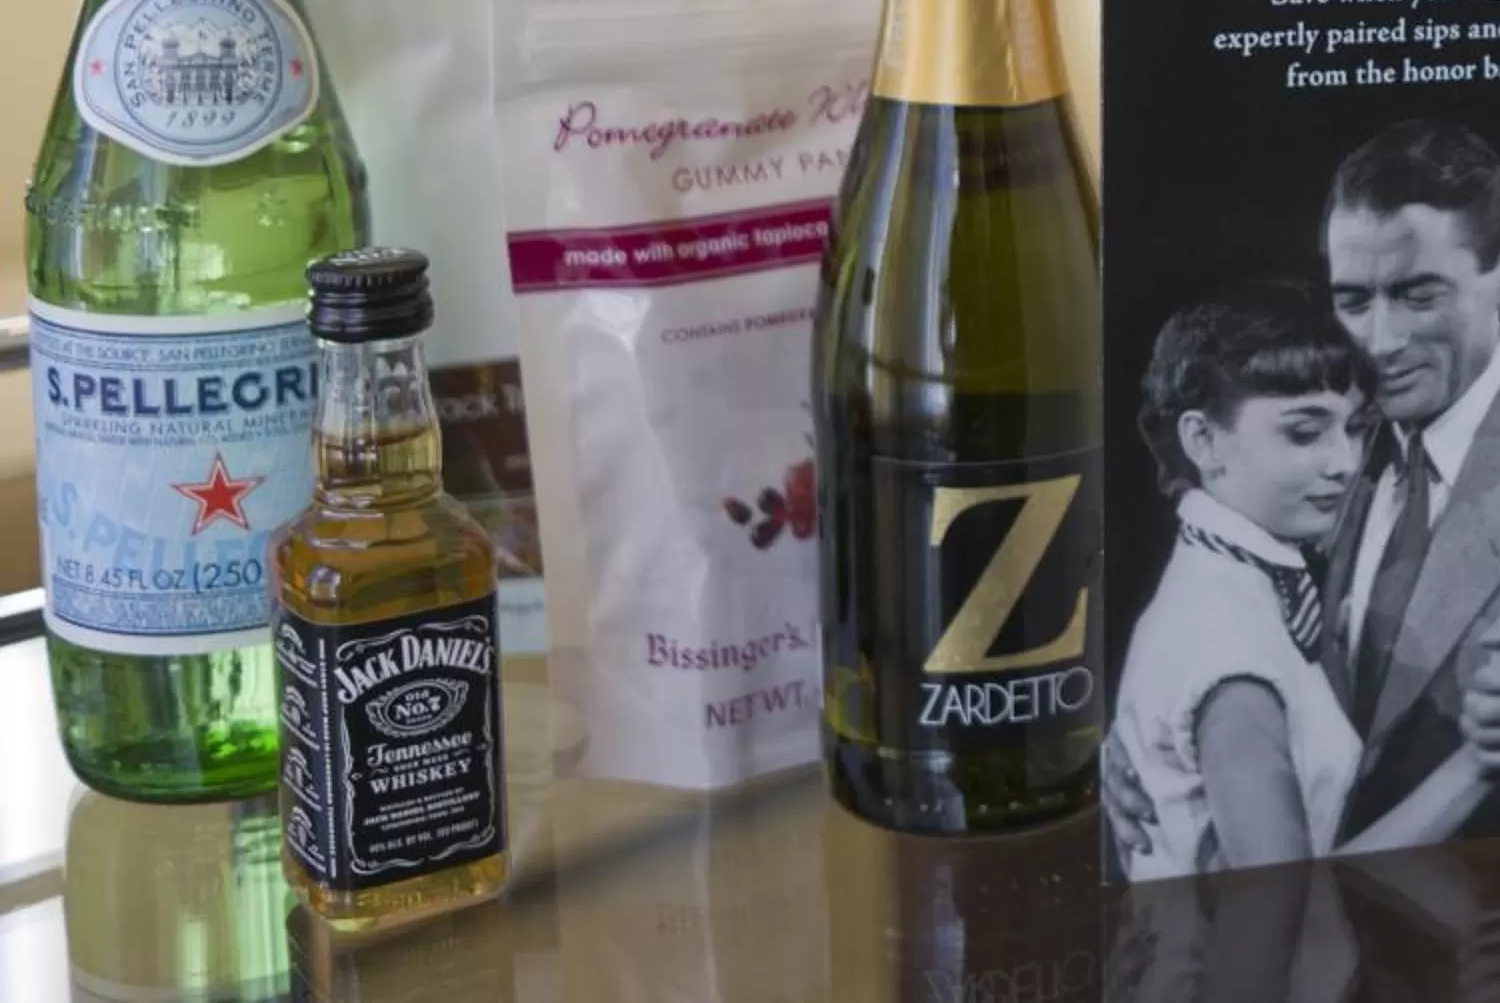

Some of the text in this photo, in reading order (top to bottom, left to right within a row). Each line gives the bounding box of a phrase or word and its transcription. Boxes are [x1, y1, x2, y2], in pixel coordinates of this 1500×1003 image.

[1213, 21, 1319, 57] expertly
[1327, 19, 1406, 52] paired
[1413, 19, 1461, 49] sips
[1286, 64, 1348, 88] from
[1355, 60, 1397, 84] the
[1402, 58, 1476, 82] honor
[554, 100, 797, 160] Pomegranate
[671, 147, 851, 193] GUMMY PAN
[564, 246, 626, 267] made
[634, 241, 674, 263] with
[676, 231, 749, 261] organic
[47, 362, 318, 418] S.PELLEGRI
[150, 419, 233, 436] NATURAL
[243, 406, 311, 429] MINERA
[56, 557, 82, 580] NET
[152, 569, 186, 590] OZ
[924, 473, 1088, 674] Z
[333, 648, 401, 704] JACK
[400, 634, 492, 675] DANIEL'S
[705, 691, 756, 728] NET
[918, 666, 1094, 726] ZARDETTO
[367, 731, 472, 768] Tennessee
[368, 757, 473, 795] WHISKEY
